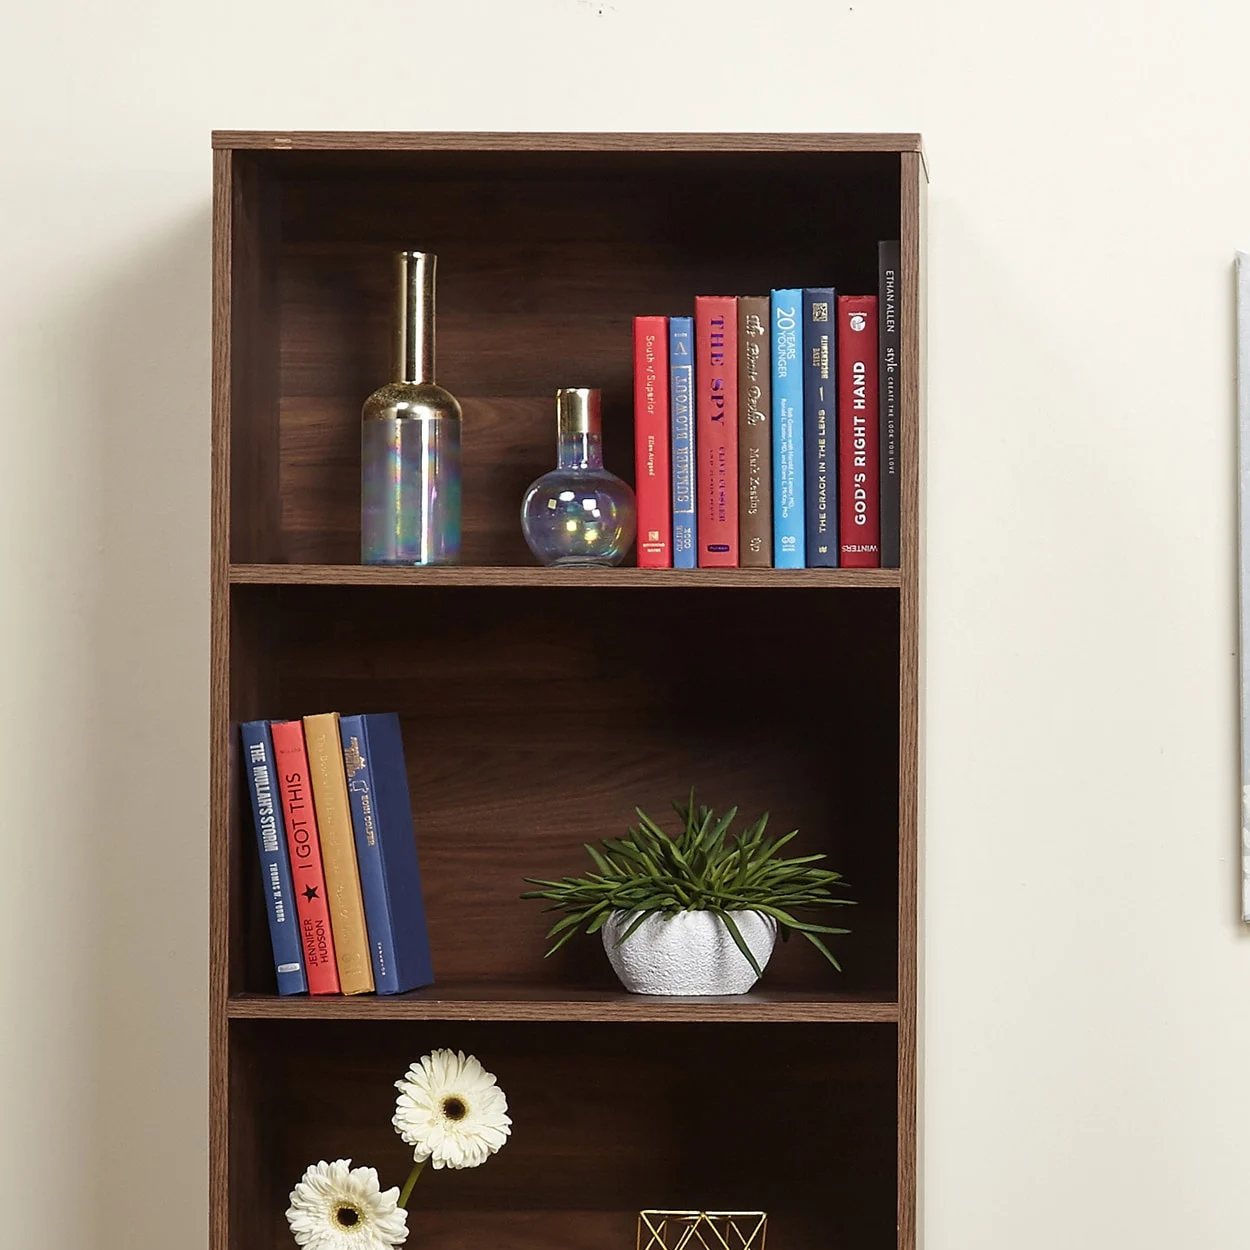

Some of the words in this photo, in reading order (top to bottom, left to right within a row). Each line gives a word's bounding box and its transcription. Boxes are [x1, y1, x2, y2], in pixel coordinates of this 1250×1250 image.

[885, 270, 894, 302] ETHAN
[746, 315, 765, 337] The
[776, 307, 796, 330] 20
[786, 330, 796, 360] YEARS
[886, 303, 895, 332] ALLEN
[646, 335, 655, 363] South
[711, 315, 724, 366] THE
[777, 331, 788, 378] YOUNGER
[885, 347, 898, 373] style
[645, 374, 656, 414] Superior
[711, 378, 724, 426] SPY
[853, 361, 866, 410] HAND
[675, 376, 688, 439] BLOWOUT
[818, 409, 826, 436] LENS
[818, 438, 826, 459] THE
[853, 415, 866, 467] RIGHT
[677, 447, 689, 502] SUMMER
[749, 448, 760, 474] Mark
[818, 462, 826, 472] IN
[748, 477, 760, 515] Keating
[818, 475, 826, 510] CRACK
[854, 473, 867, 525] GOD'S
[683, 528, 691, 549] COOK
[818, 512, 826, 533] THE
[841, 545, 878, 553] WINTERS
[249, 742, 266, 763] THE
[253, 765, 274, 816] MULLAH'S
[286, 773, 305, 814] THIS
[260, 816, 279, 852] STORM
[292, 819, 311, 858] GOT
[269, 863, 280, 890] THOMAS
[275, 900, 285, 923] YOUNG
[304, 919, 319, 967] JENNIFER
[316, 920, 329, 963] HUDSON
